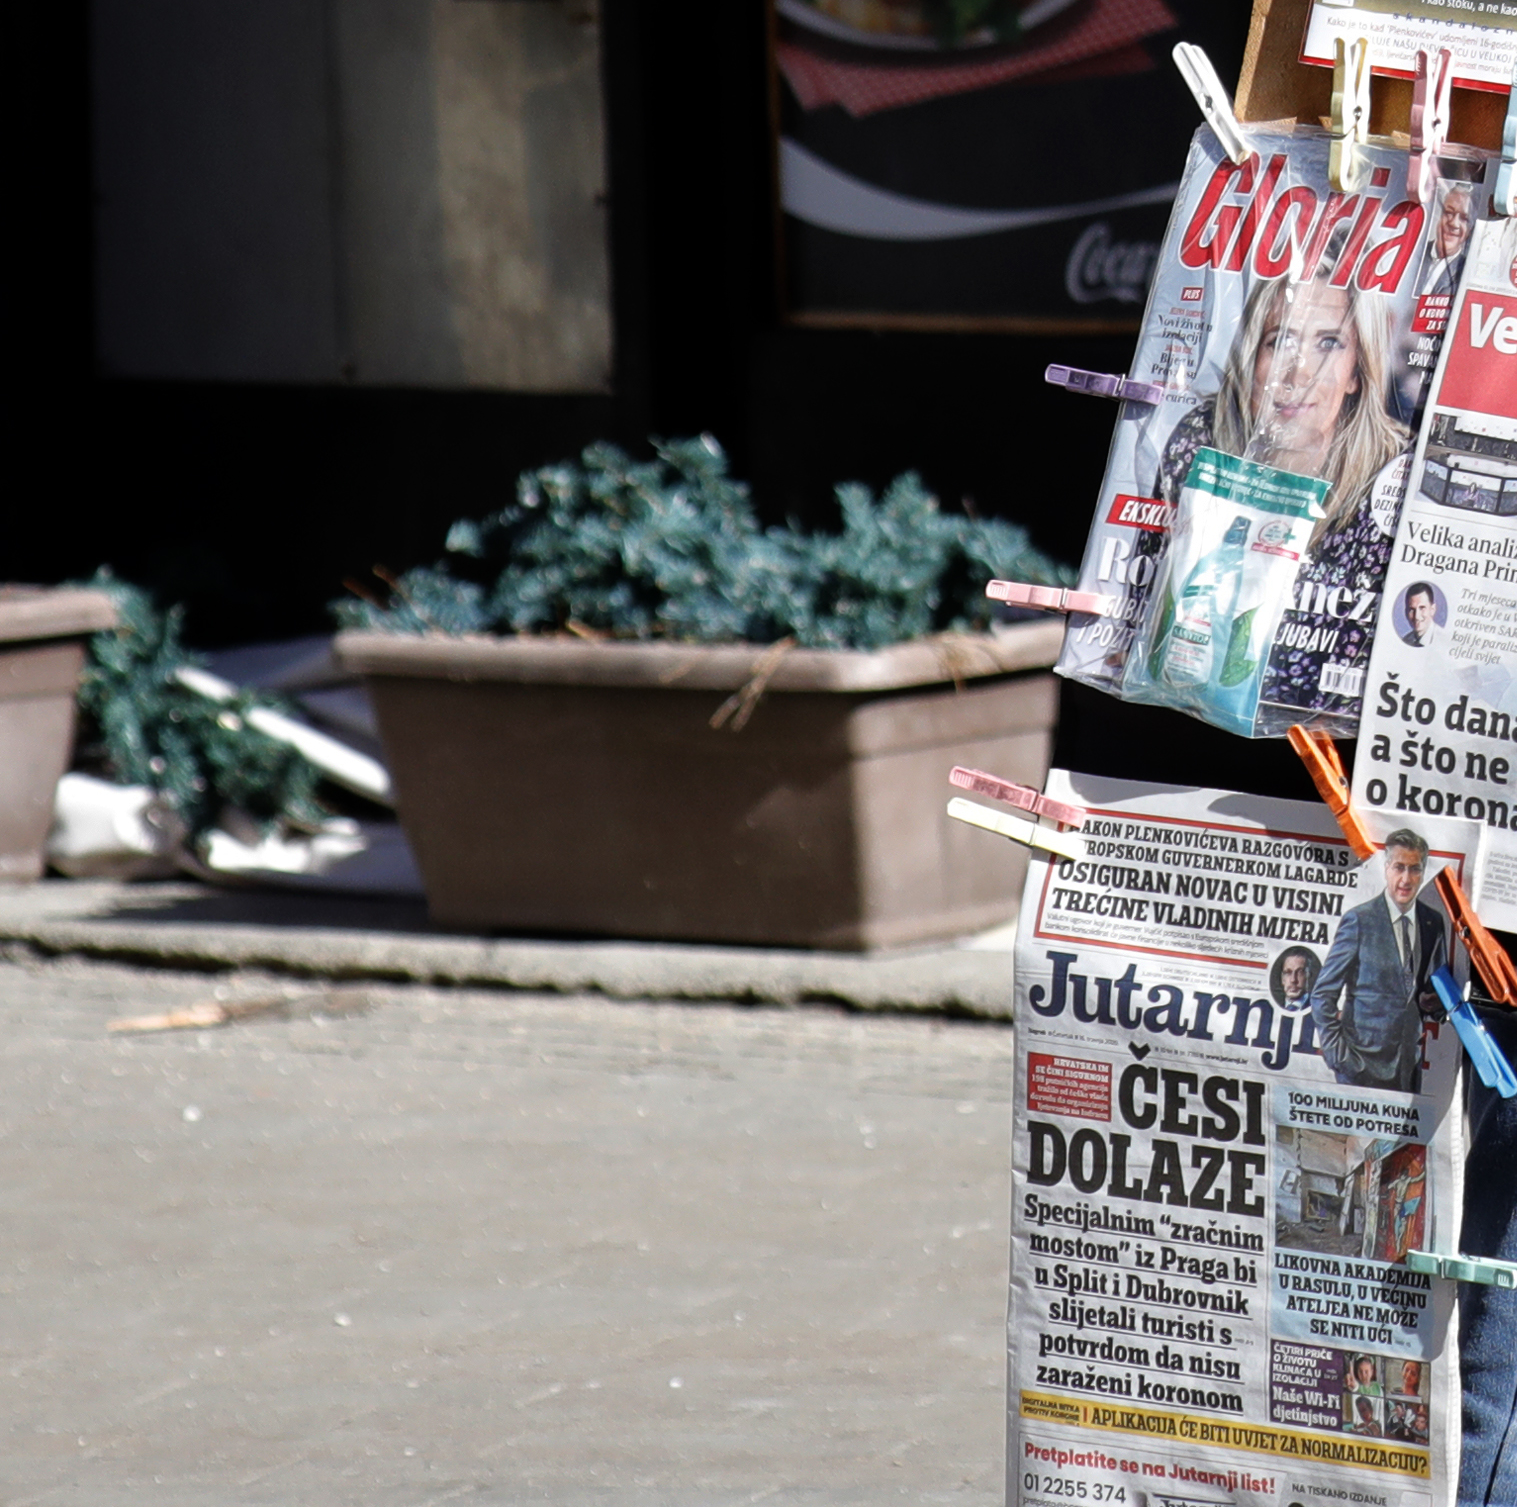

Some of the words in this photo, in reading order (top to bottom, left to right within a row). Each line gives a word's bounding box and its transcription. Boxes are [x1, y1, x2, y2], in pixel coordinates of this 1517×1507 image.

[1178, 152, 1427, 294] Gloria
[1401, 544, 1479, 576] Dragana
[1407, 521, 1464, 552] Velika
[1376, 672, 1435, 725] Što
[1370, 733, 1390, 762] a
[1400, 730, 1455, 774] što
[1464, 751, 1509, 784] ne
[1366, 777, 1387, 805] o
[1078, 820, 1122, 839] AKON
[1124, 823, 1238, 853] PLENKOVIĆEVA
[1241, 836, 1335, 865] RAZGOVORA
[1338, 851, 1349, 867] S
[1085, 840, 1160, 863] ROPSKOM
[1162, 850, 1280, 878] GUVERNERKOM
[1284, 866, 1359, 889] LAGARDE
[1058, 861, 1172, 891] OSIGURAN
[1175, 874, 1248, 904] NOVAC
[1253, 885, 1268, 907] U
[1272, 887, 1344, 916] VISINI
[1052, 888, 1148, 920] TREĆINE
[1153, 903, 1254, 935] VLADINIH
[1257, 917, 1329, 945] MJERA
[1118, 1041, 1266, 1146] ČESI
[1288, 1092, 1313, 1106] 100
[1316, 1096, 1379, 1115] MILIJUNA
[1382, 1104, 1419, 1121] KUNA
[1289, 1105, 1330, 1125] ŠTETE
[1333, 1115, 1353, 1128] OD
[1356, 1119, 1419, 1138] POTRESA
[1025, 1121, 1266, 1217] DOLAZE
[1024, 1193, 1155, 1236] Specijalnim
[1135, 1244, 1155, 1268] iz
[1161, 1246, 1228, 1284] Praga
[1234, 1257, 1257, 1283] bi
[1275, 1253, 1341, 1277] LIKOVNA
[1344, 1263, 1431, 1290] AKADEMIJA
[1035, 1267, 1048, 1285] u
[1053, 1264, 1107, 1296] Split
[1112, 1273, 1120, 1295] i
[1126, 1274, 1249, 1315] Dubrovnik
[1279, 1274, 1289, 1289] U
[1292, 1276, 1355, 1301] RASULU,
[1358, 1284, 1370, 1300] U
[1372, 1285, 1427, 1309] VEĆINU
[1286, 1295, 1350, 1319] ATELJEA
[1353, 1305, 1374, 1320] NE
[1376, 1306, 1418, 1328] MOŽE
[1049, 1297, 1136, 1330] slijetali
[1142, 1313, 1214, 1342] turisti
[1220, 1327, 1233, 1345] s
[1310, 1319, 1329, 1335] SE
[1331, 1323, 1364, 1341] NITI
[1367, 1324, 1392, 1344] UĆI
[1039, 1333, 1150, 1366] potvrdom
[1156, 1345, 1183, 1371] da
[1189, 1352, 1241, 1380] nisu
[1036, 1365, 1132, 1396] zaraženi
[1138, 1374, 1243, 1412] koronom
[1272, 1386, 1303, 1404] Naše
[1305, 1391, 1340, 1409] Wi-Fi
[1273, 1405, 1337, 1427] djetinjstvo
[1090, 1408, 1177, 1437] APLIKACIJA
[1181, 1416, 1198, 1439] ĆE
[1200, 1422, 1230, 1443] BITI
[1234, 1428, 1277, 1450] UVJET
[1280, 1436, 1298, 1452] ZA
[1301, 1438, 1427, 1473] NORMALIZACIJU?
[1024, 1442, 1117, 1469] Pretplatite
[1120, 1460, 1139, 1473] se
[1143, 1464, 1165, 1477] na
[1169, 1465, 1238, 1492] Jutarnji
[1241, 1474, 1275, 1494] list!
[1024, 1473, 1039, 1490] 01
[1043, 1477, 1087, 1498] 2255
[1093, 1484, 1126, 1503] 374
